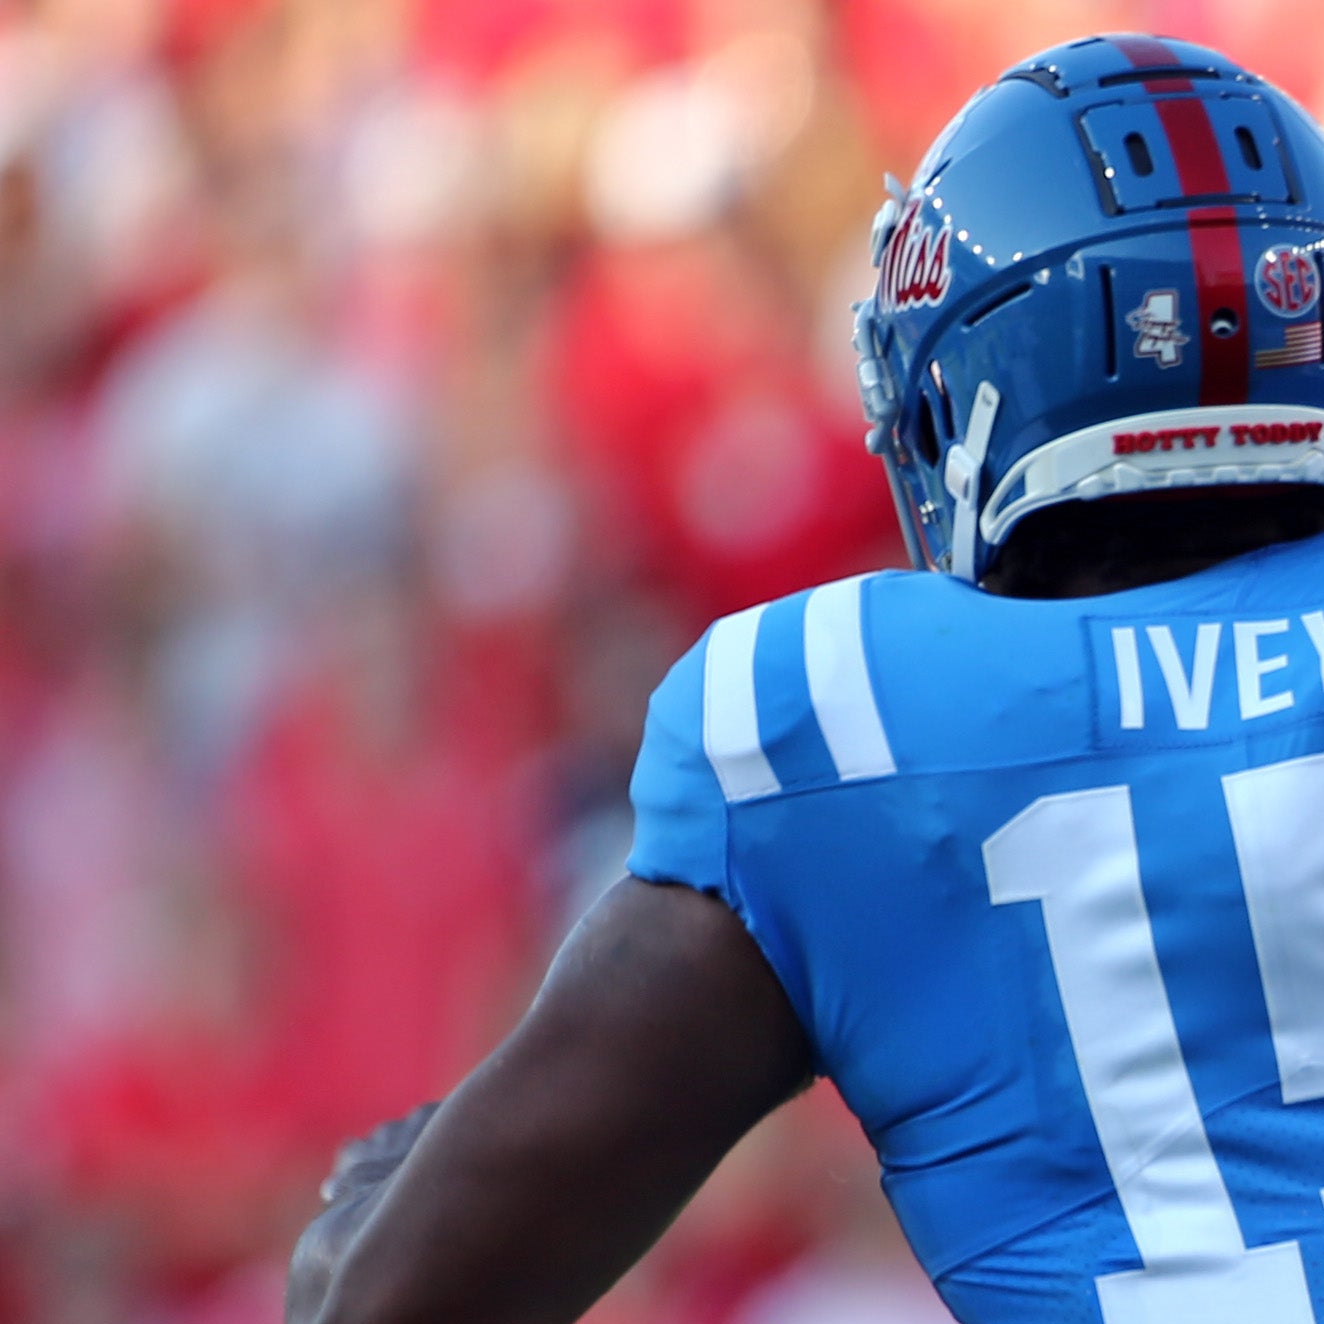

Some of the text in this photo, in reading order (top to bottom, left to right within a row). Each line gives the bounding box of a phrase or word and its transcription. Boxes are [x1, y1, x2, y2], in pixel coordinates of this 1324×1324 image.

[1263, 250, 1315, 312] SEC
[1113, 422, 1323, 455] HOTTY TODDY
